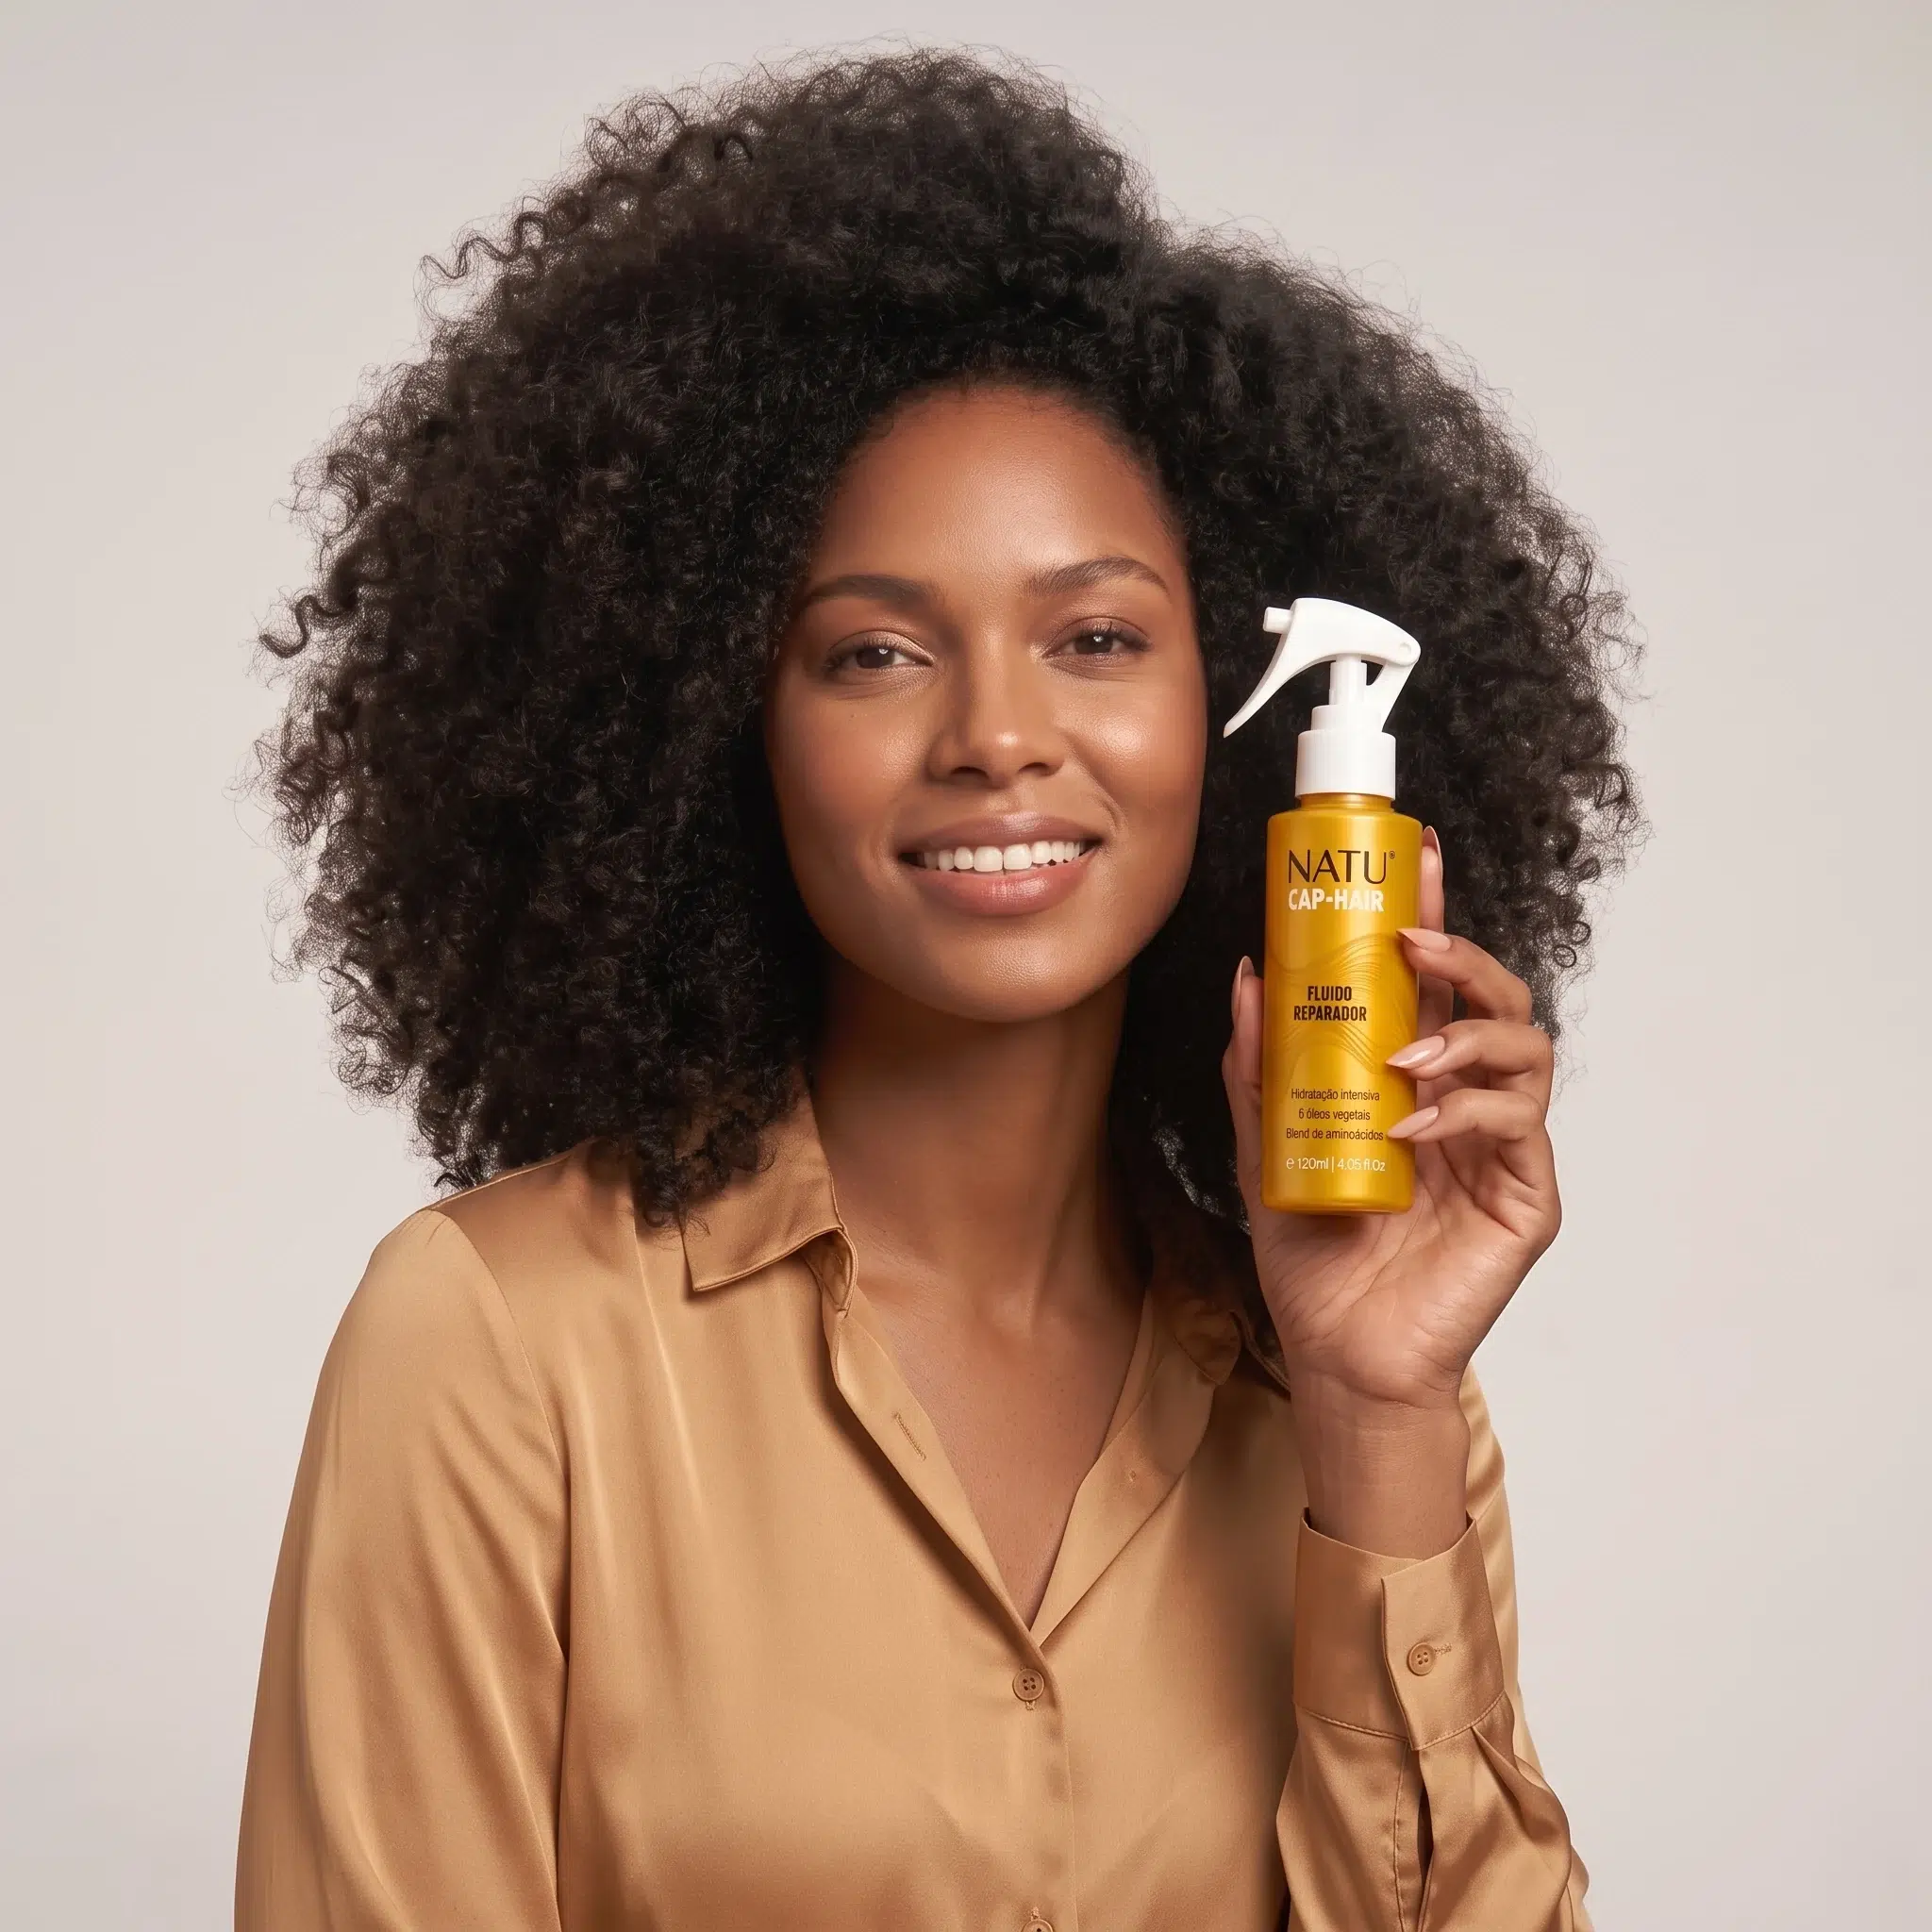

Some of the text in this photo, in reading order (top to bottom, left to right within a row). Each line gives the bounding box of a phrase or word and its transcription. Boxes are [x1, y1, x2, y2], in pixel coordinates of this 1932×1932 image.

[1289, 888, 1384, 912] CAP-HAIR
[1307, 986, 1352, 1001] FLUIDO
[1293, 1006, 1367, 1021] REPARADOR
[1291, 1089, 1380, 1101] Hidratação intensiva
[1298, 1108, 1370, 1122] 6 óleos vegetais
[1286, 1128, 1384, 1141] Blend de aminoácidos
[1298, 1158, 1328, 1170] 120ml
[1338, 1158, 1361, 1170] 4.05
